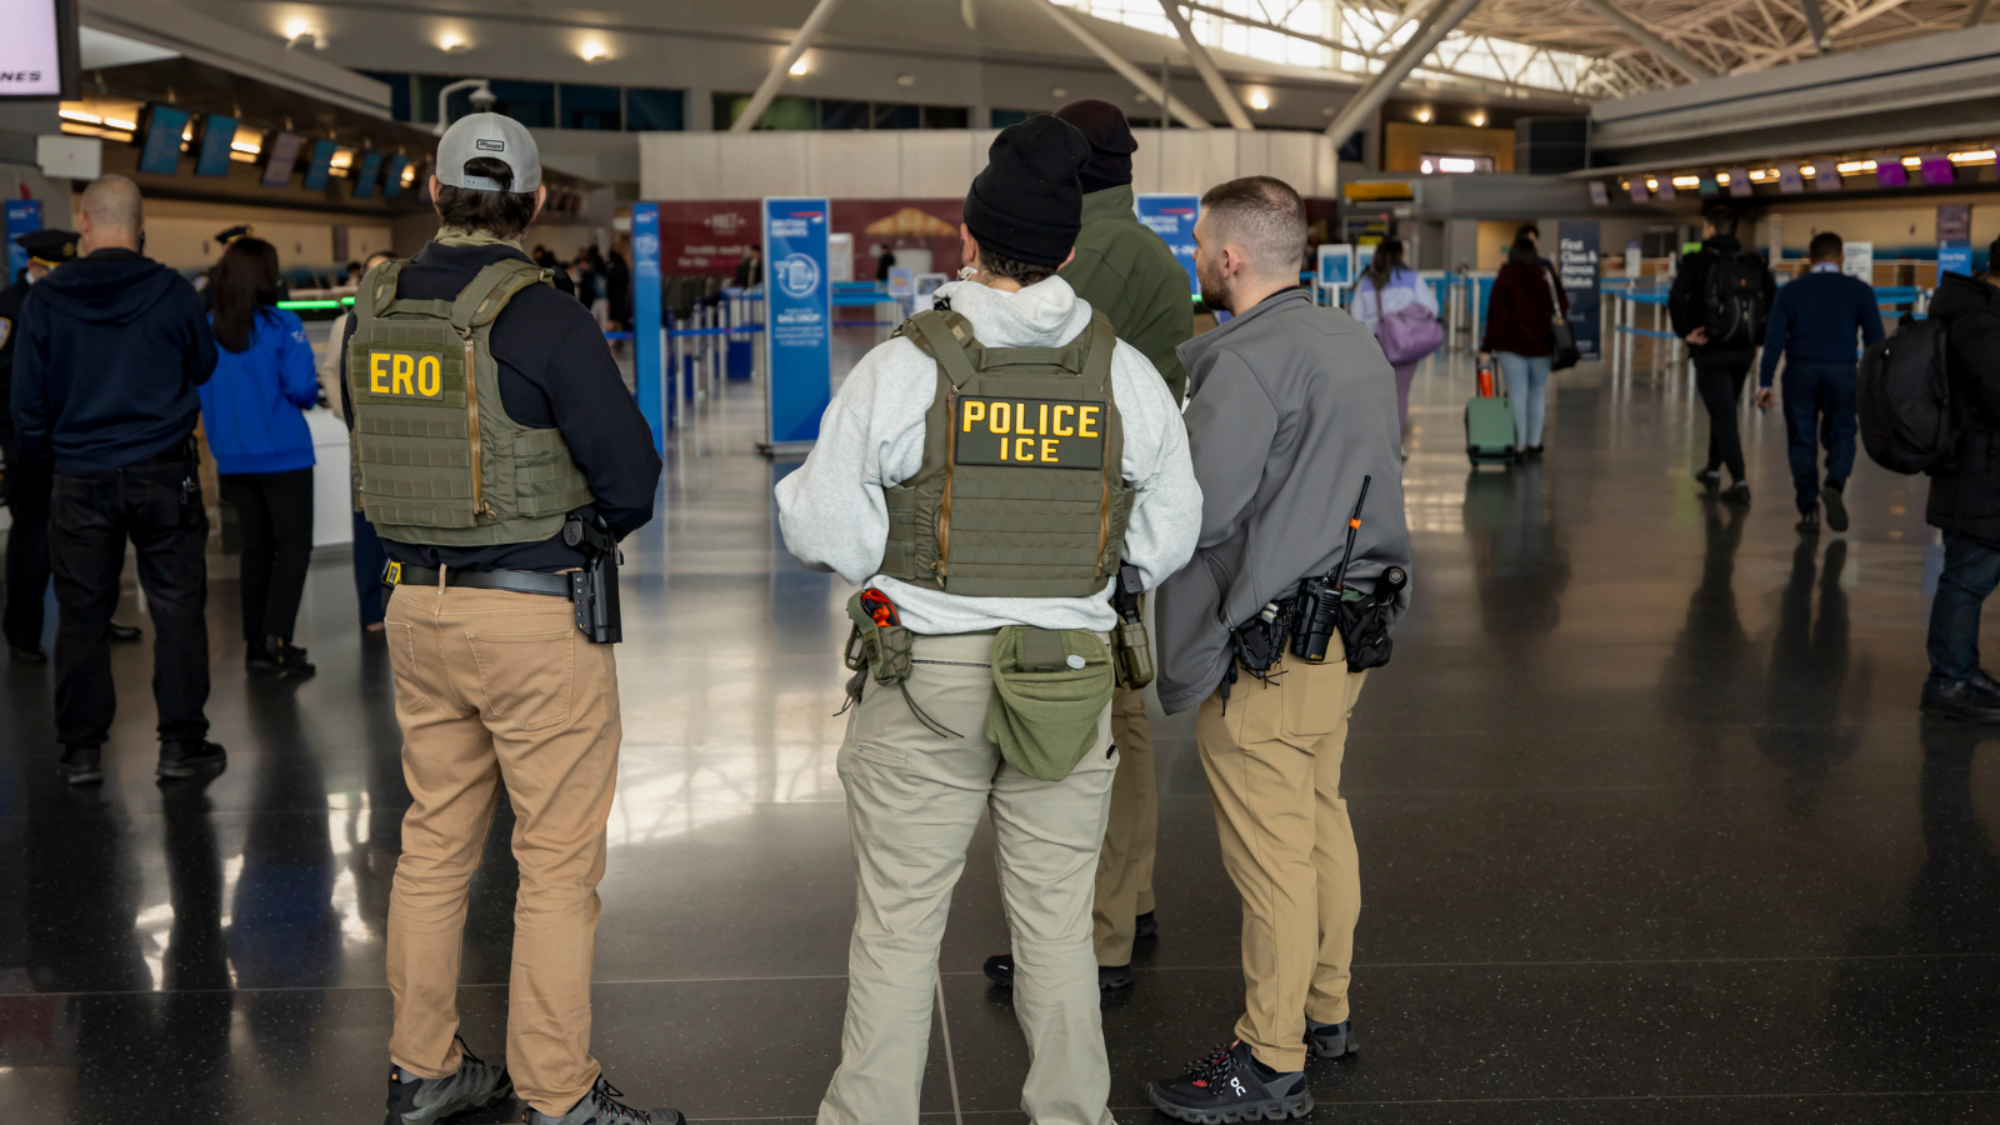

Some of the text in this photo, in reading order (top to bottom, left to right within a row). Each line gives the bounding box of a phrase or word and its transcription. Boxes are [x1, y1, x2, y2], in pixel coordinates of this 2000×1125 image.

[0, 71, 42, 82] NES
[370, 352, 440, 397] ERO
[963, 400, 1100, 438] POLICE
[1000, 437, 1060, 462] ICE
